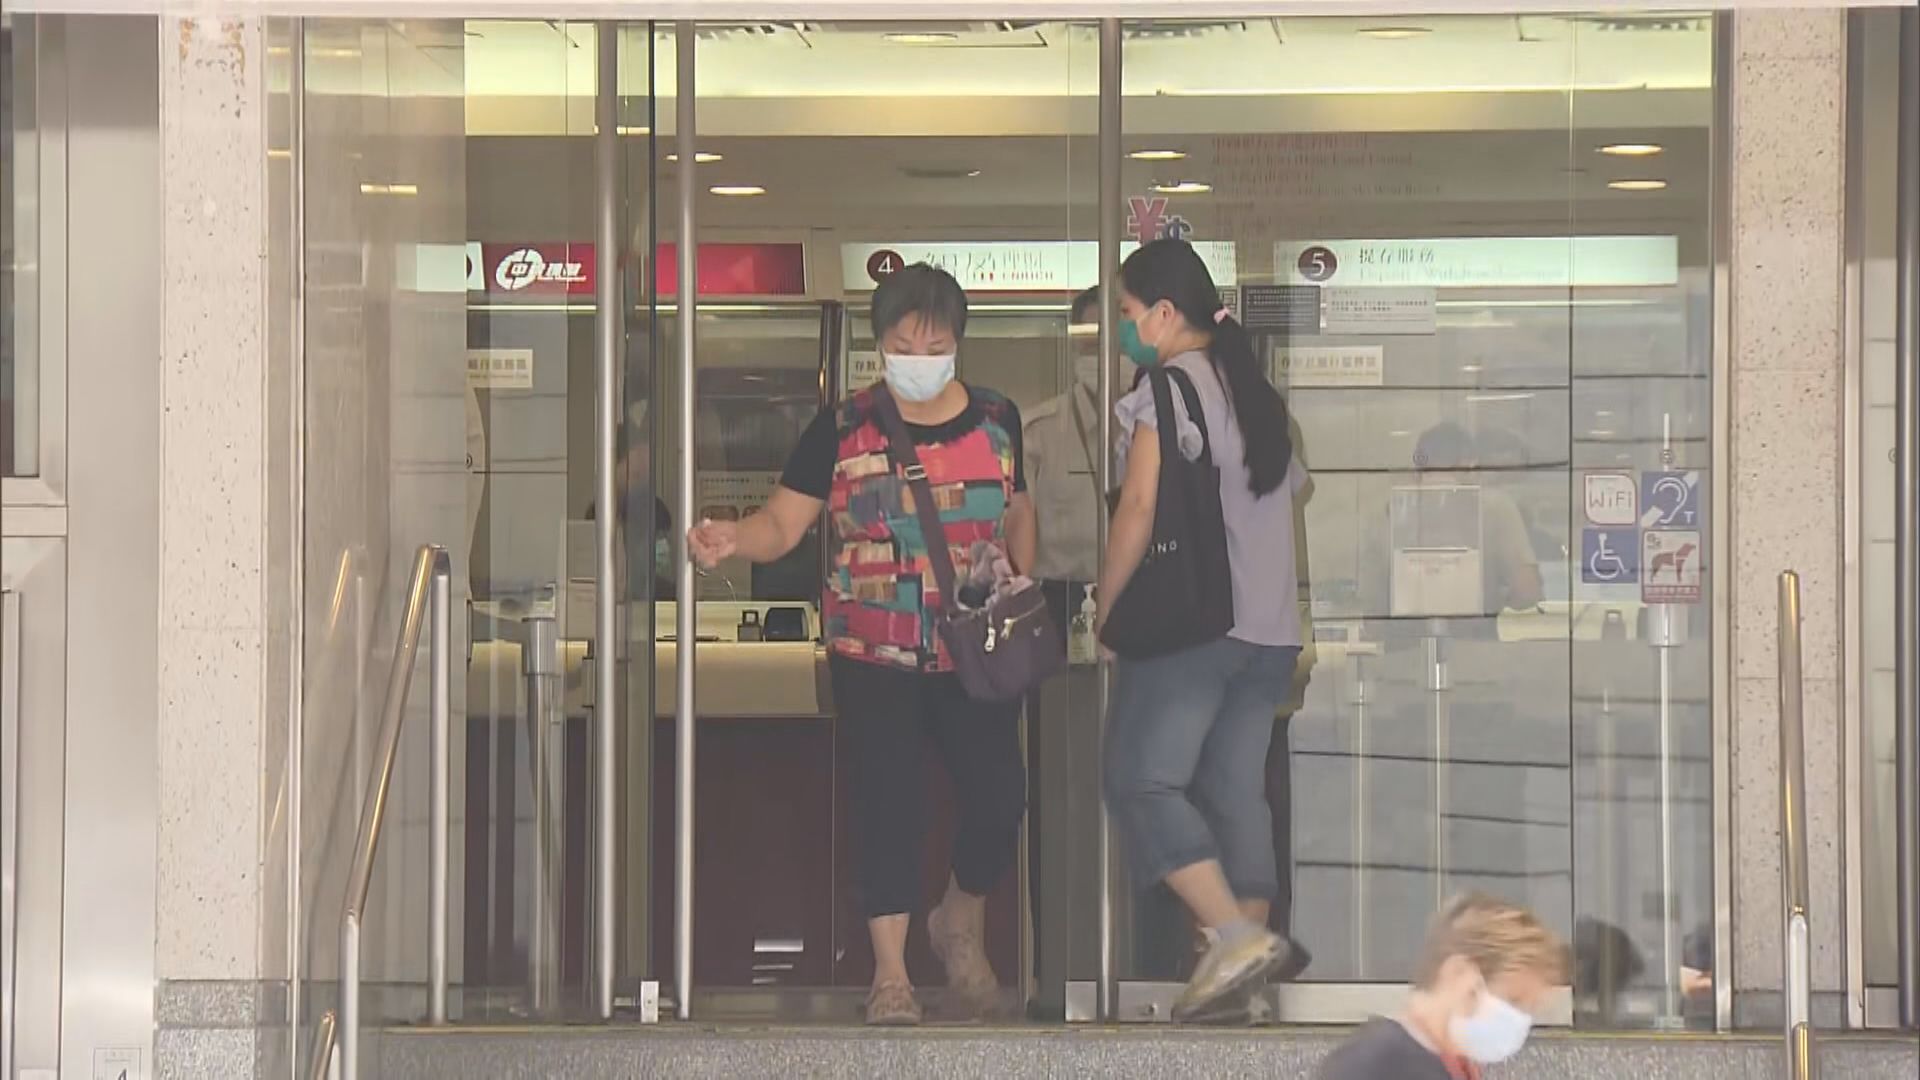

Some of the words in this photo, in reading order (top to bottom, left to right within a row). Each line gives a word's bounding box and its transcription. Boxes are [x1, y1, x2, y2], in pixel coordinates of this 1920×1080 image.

[877, 255, 895, 275] 4
[1309, 252, 1326, 276] 5
[1684, 511, 1695, 524] T
